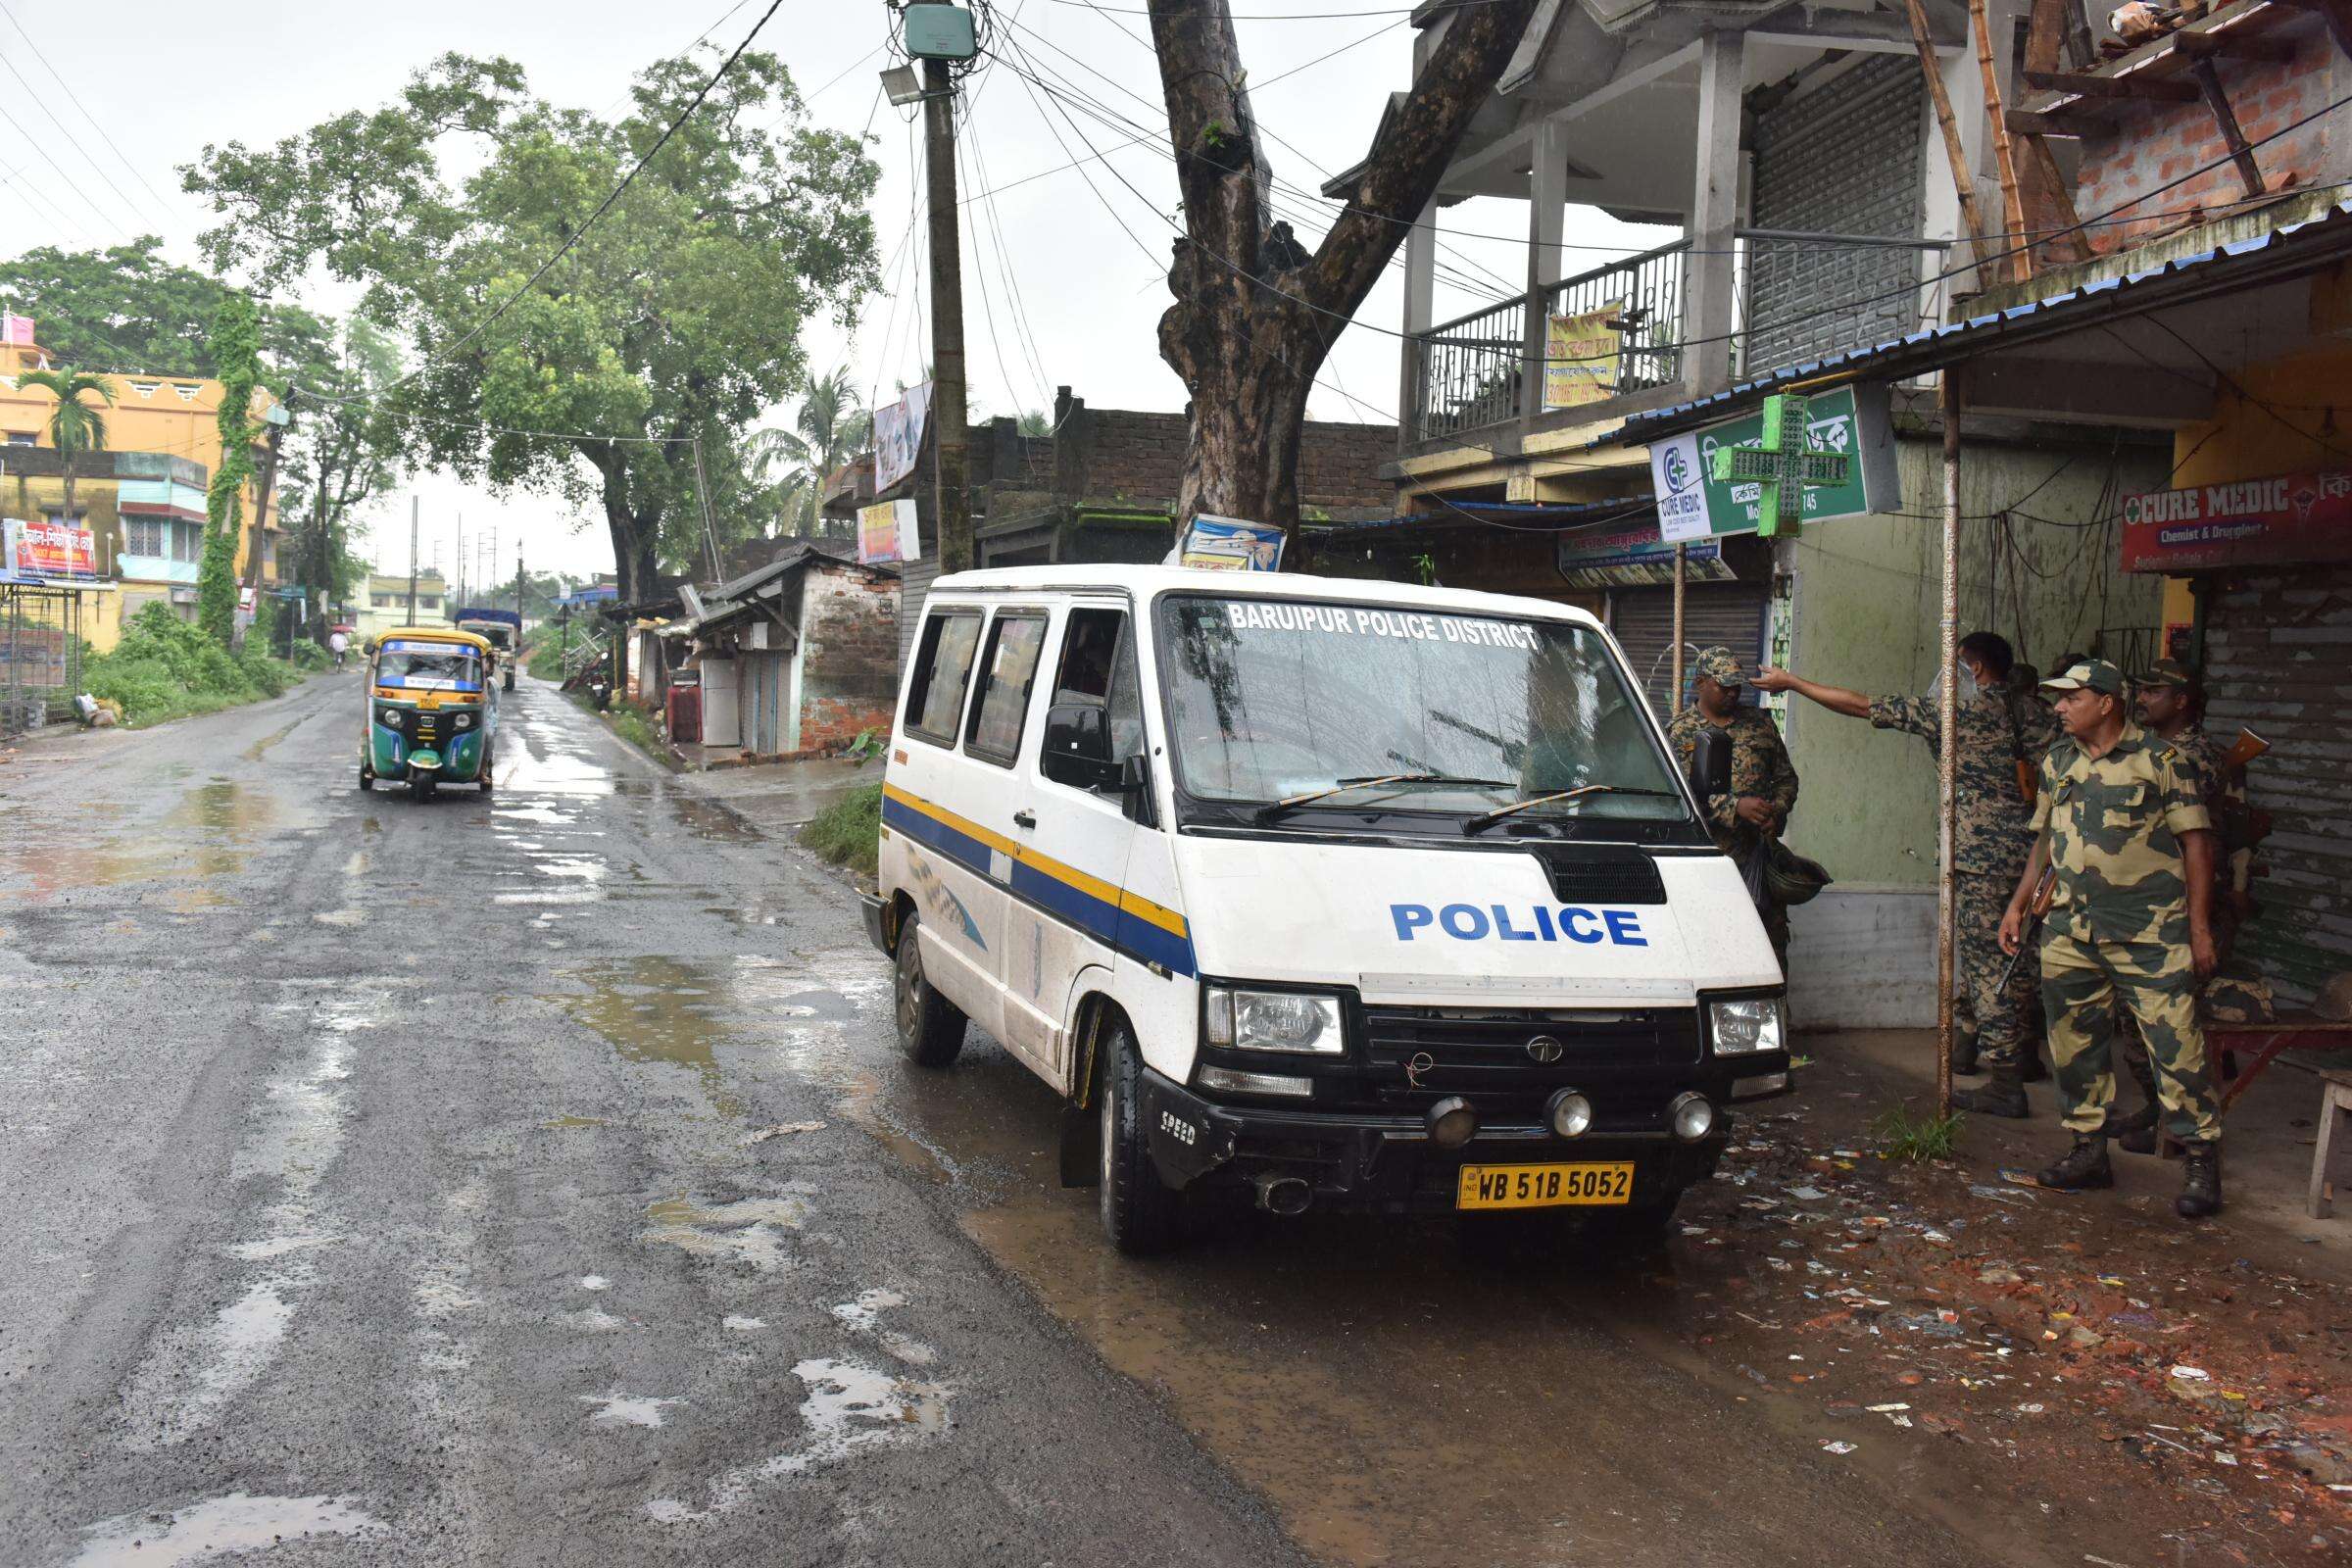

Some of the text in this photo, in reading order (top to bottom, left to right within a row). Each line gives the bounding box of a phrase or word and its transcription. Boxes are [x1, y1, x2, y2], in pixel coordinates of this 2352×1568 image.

[1661, 493, 1701, 517] CURE MEDIC
[2141, 478, 2289, 524] CURE MEDIC
[2160, 527, 2199, 544] Chemist
[2202, 525, 2209, 540] &
[1227, 604, 1540, 651] BARUIPUR POLICE DISTRICT
[1390, 904, 1648, 947] POLICE
[1160, 1110, 1196, 1146] SPEED
[1479, 1170, 1629, 1201] WB 51B 5052
